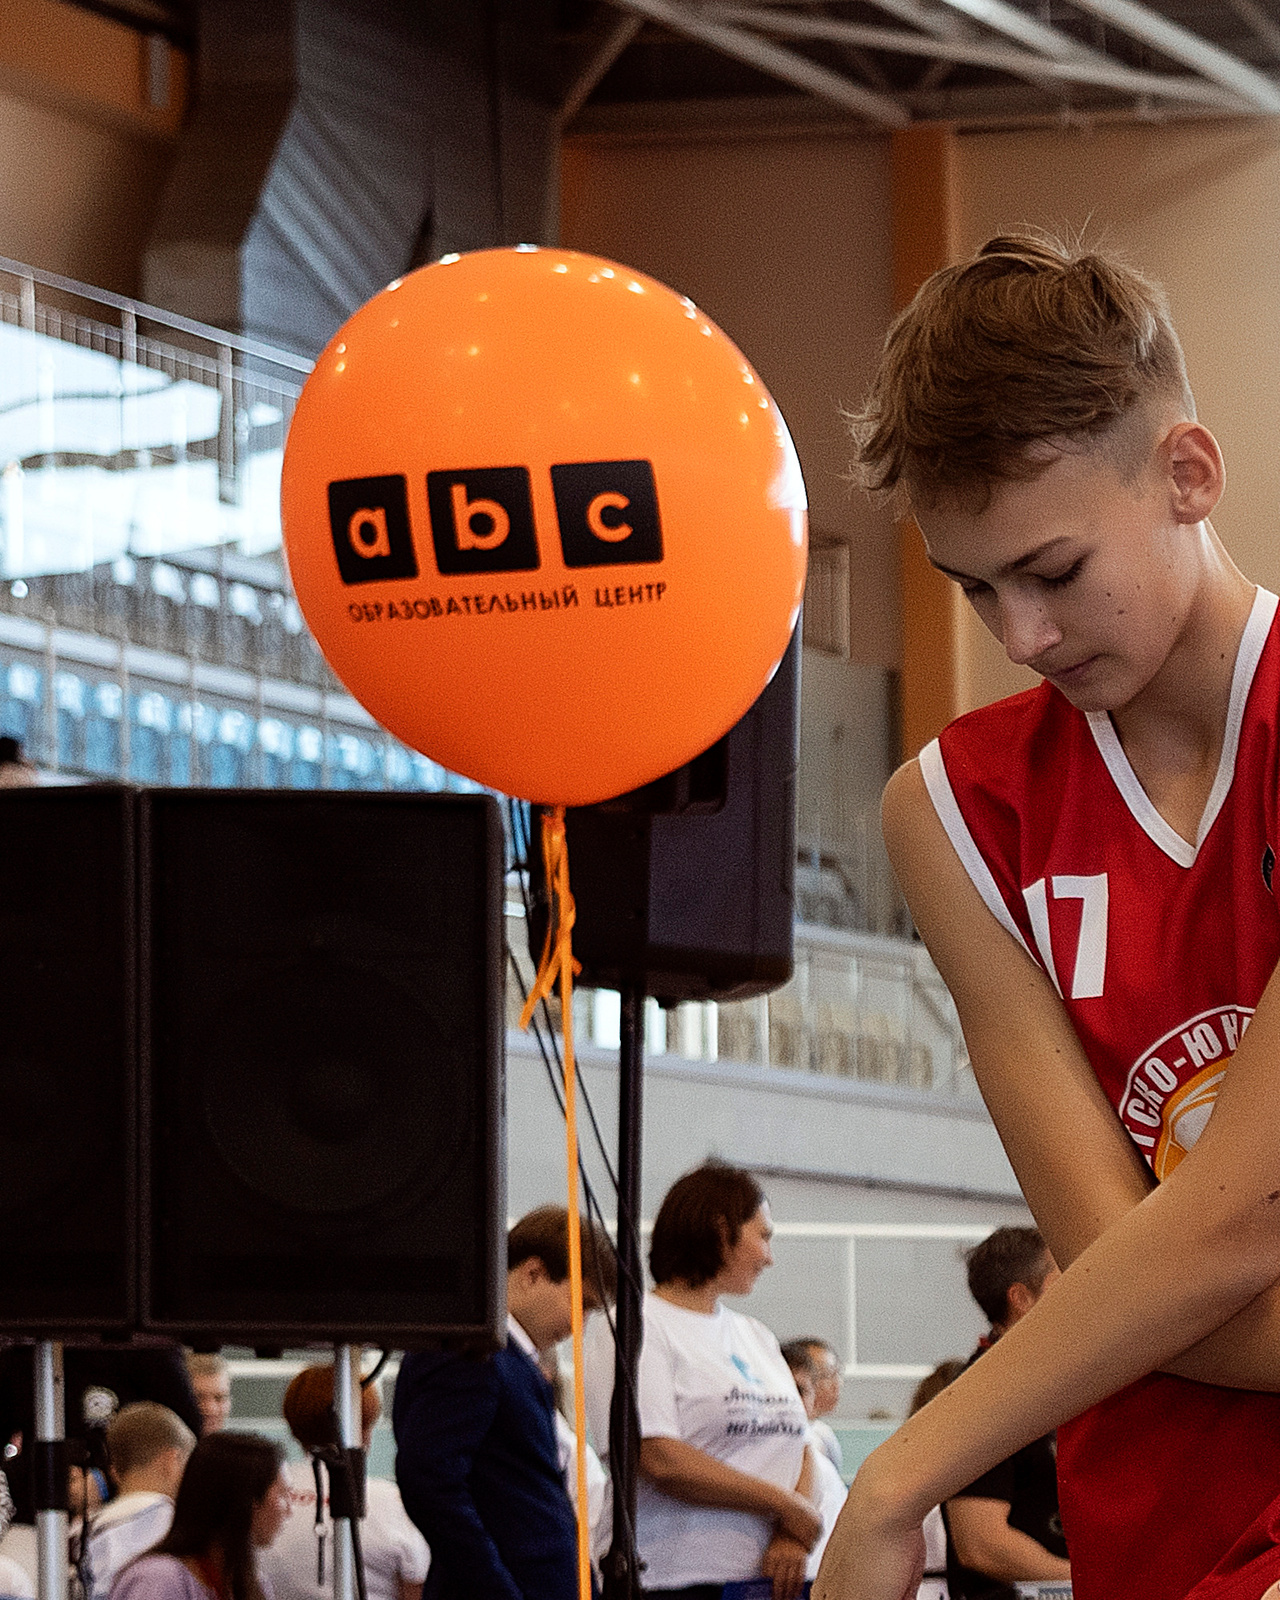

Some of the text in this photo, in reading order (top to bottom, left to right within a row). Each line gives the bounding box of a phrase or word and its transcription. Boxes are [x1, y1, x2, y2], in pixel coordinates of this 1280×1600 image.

[349, 581, 667, 622] ОБРАЗОВАТЕЛЬНЫЙ ЦЕНТР
[1021, 871, 1109, 1000] 17
